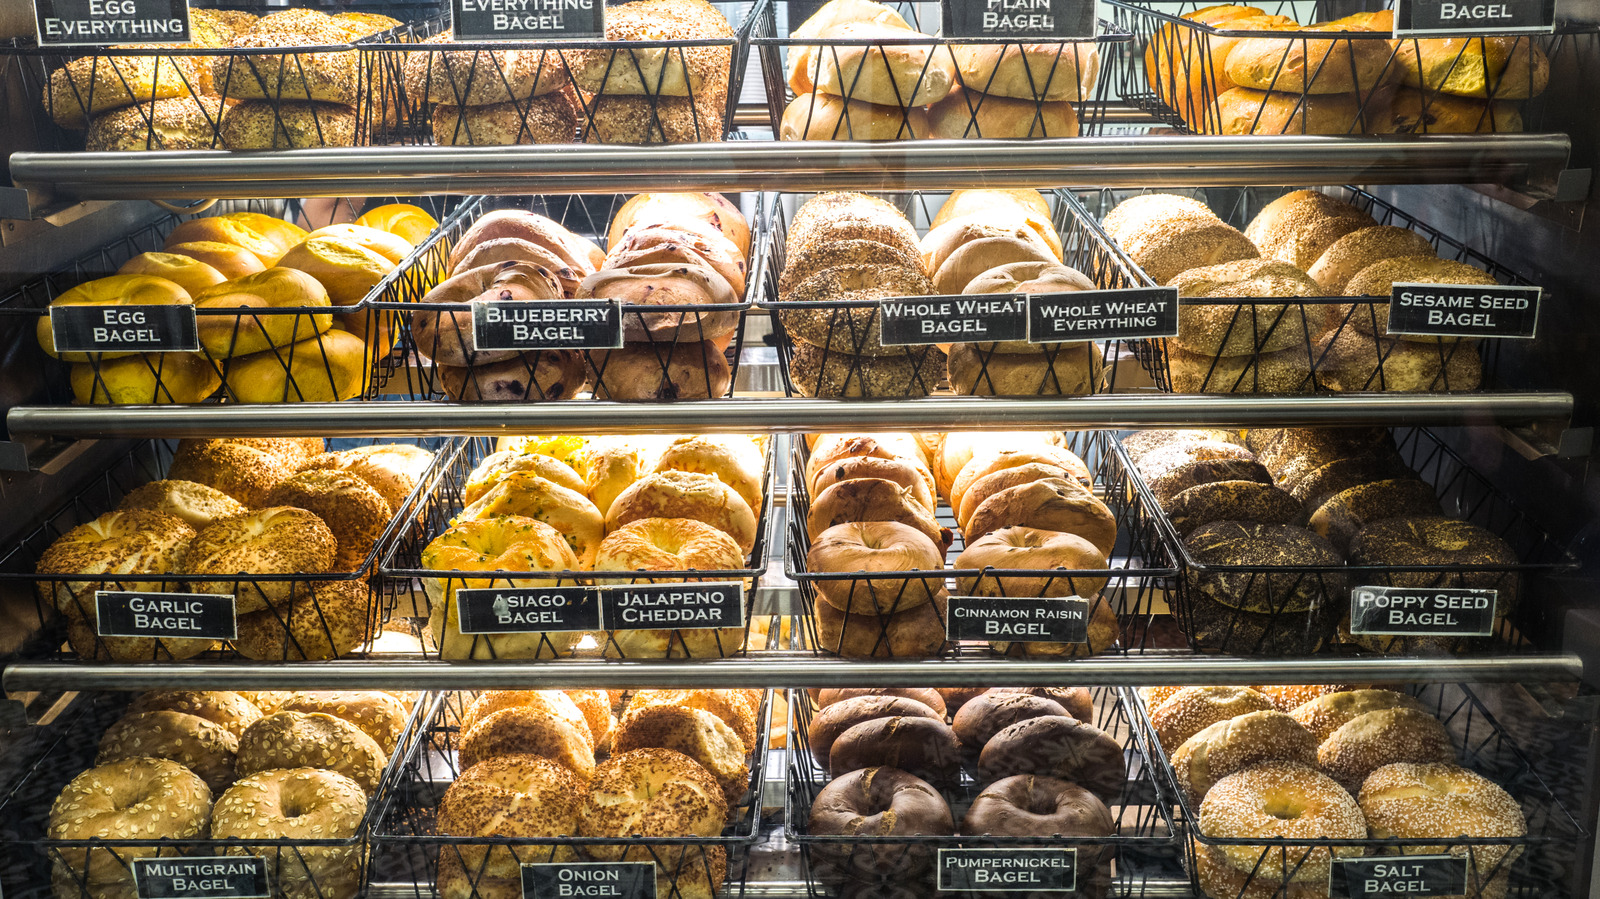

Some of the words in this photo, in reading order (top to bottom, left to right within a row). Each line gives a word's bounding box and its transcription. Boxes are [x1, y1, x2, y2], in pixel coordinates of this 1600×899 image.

[90, 0, 136, 16] EGG
[462, 0, 594, 12] EVERYTHING
[1440, 3, 1512, 19] BAGEL
[45, 18, 184, 35] EVERYTHING
[493, 15, 565, 30] BAGEL
[982, 12, 1055, 29] BAGEL
[883, 302, 952, 317] WHOLE
[956, 299, 1025, 315] WHEAT
[1400, 292, 1473, 307] SESAME
[1479, 294, 1529, 309] SEED
[103, 310, 146, 325] EGG
[486, 307, 611, 324] BLUEBERRY
[1040, 304, 1100, 318] WHOLE
[1105, 301, 1167, 315] WHEAT
[1054, 316, 1158, 332] EVERYTHING
[1427, 309, 1496, 327] BAGEL
[514, 325, 584, 341] BAGEL
[920, 319, 987, 334] BAGEL
[93, 327, 161, 343] BAGEL
[129, 598, 203, 614] GARLIC
[618, 591, 725, 607] JALAPENO
[1359, 592, 1430, 609] POPPY
[1434, 595, 1489, 609] SEED
[498, 608, 563, 624] BAGEL
[622, 607, 722, 622] CHEDDAR
[954, 607, 1031, 619] CINNAMON
[1036, 608, 1083, 620] RAISIN
[1388, 611, 1459, 625] BAGEL
[134, 614, 202, 630] BAGEL
[985, 621, 1051, 636] BAGEL
[146, 862, 257, 877] MULTIGRAIN
[946, 856, 1070, 868] PUMPERNICKEL
[558, 868, 620, 882] ONION
[975, 870, 1040, 883] BAGEL
[1374, 865, 1424, 877] SALT
[173, 877, 235, 891] BAGEL
[559, 884, 622, 897] BAGEL
[1364, 878, 1430, 892] BAGEL
